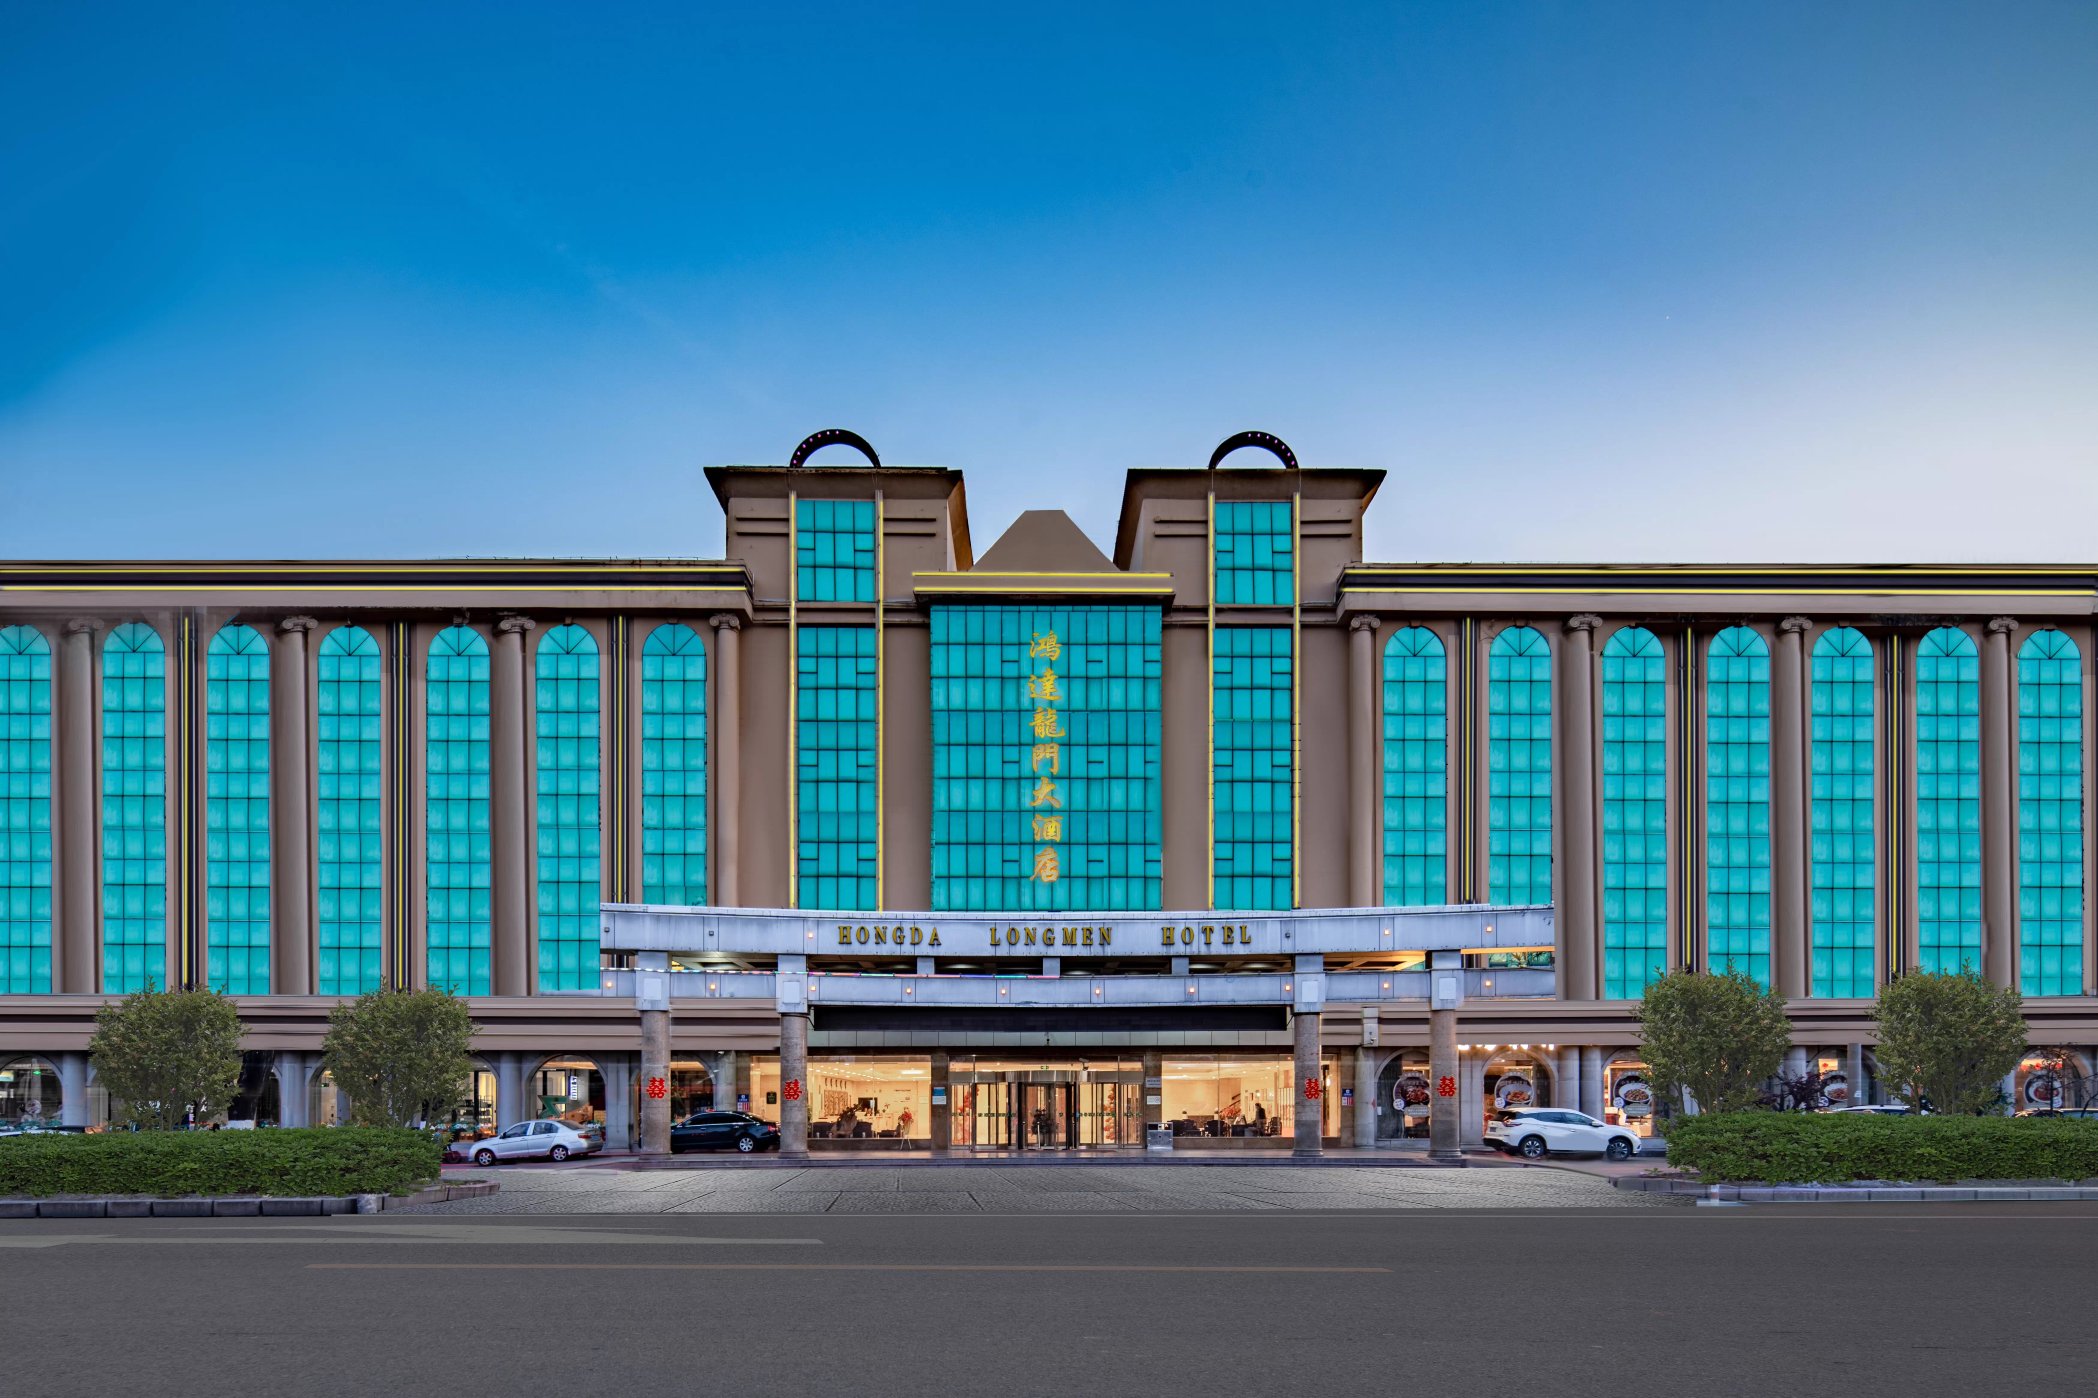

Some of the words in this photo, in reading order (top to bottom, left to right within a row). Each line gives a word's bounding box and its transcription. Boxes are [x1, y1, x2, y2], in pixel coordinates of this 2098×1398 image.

[1028, 631, 1066, 883] 鴻達龍門大酒店
[838, 925, 941, 946] HONGDA
[990, 926, 1113, 946] LONGMEN
[1162, 925, 1252, 946] HOTEL
